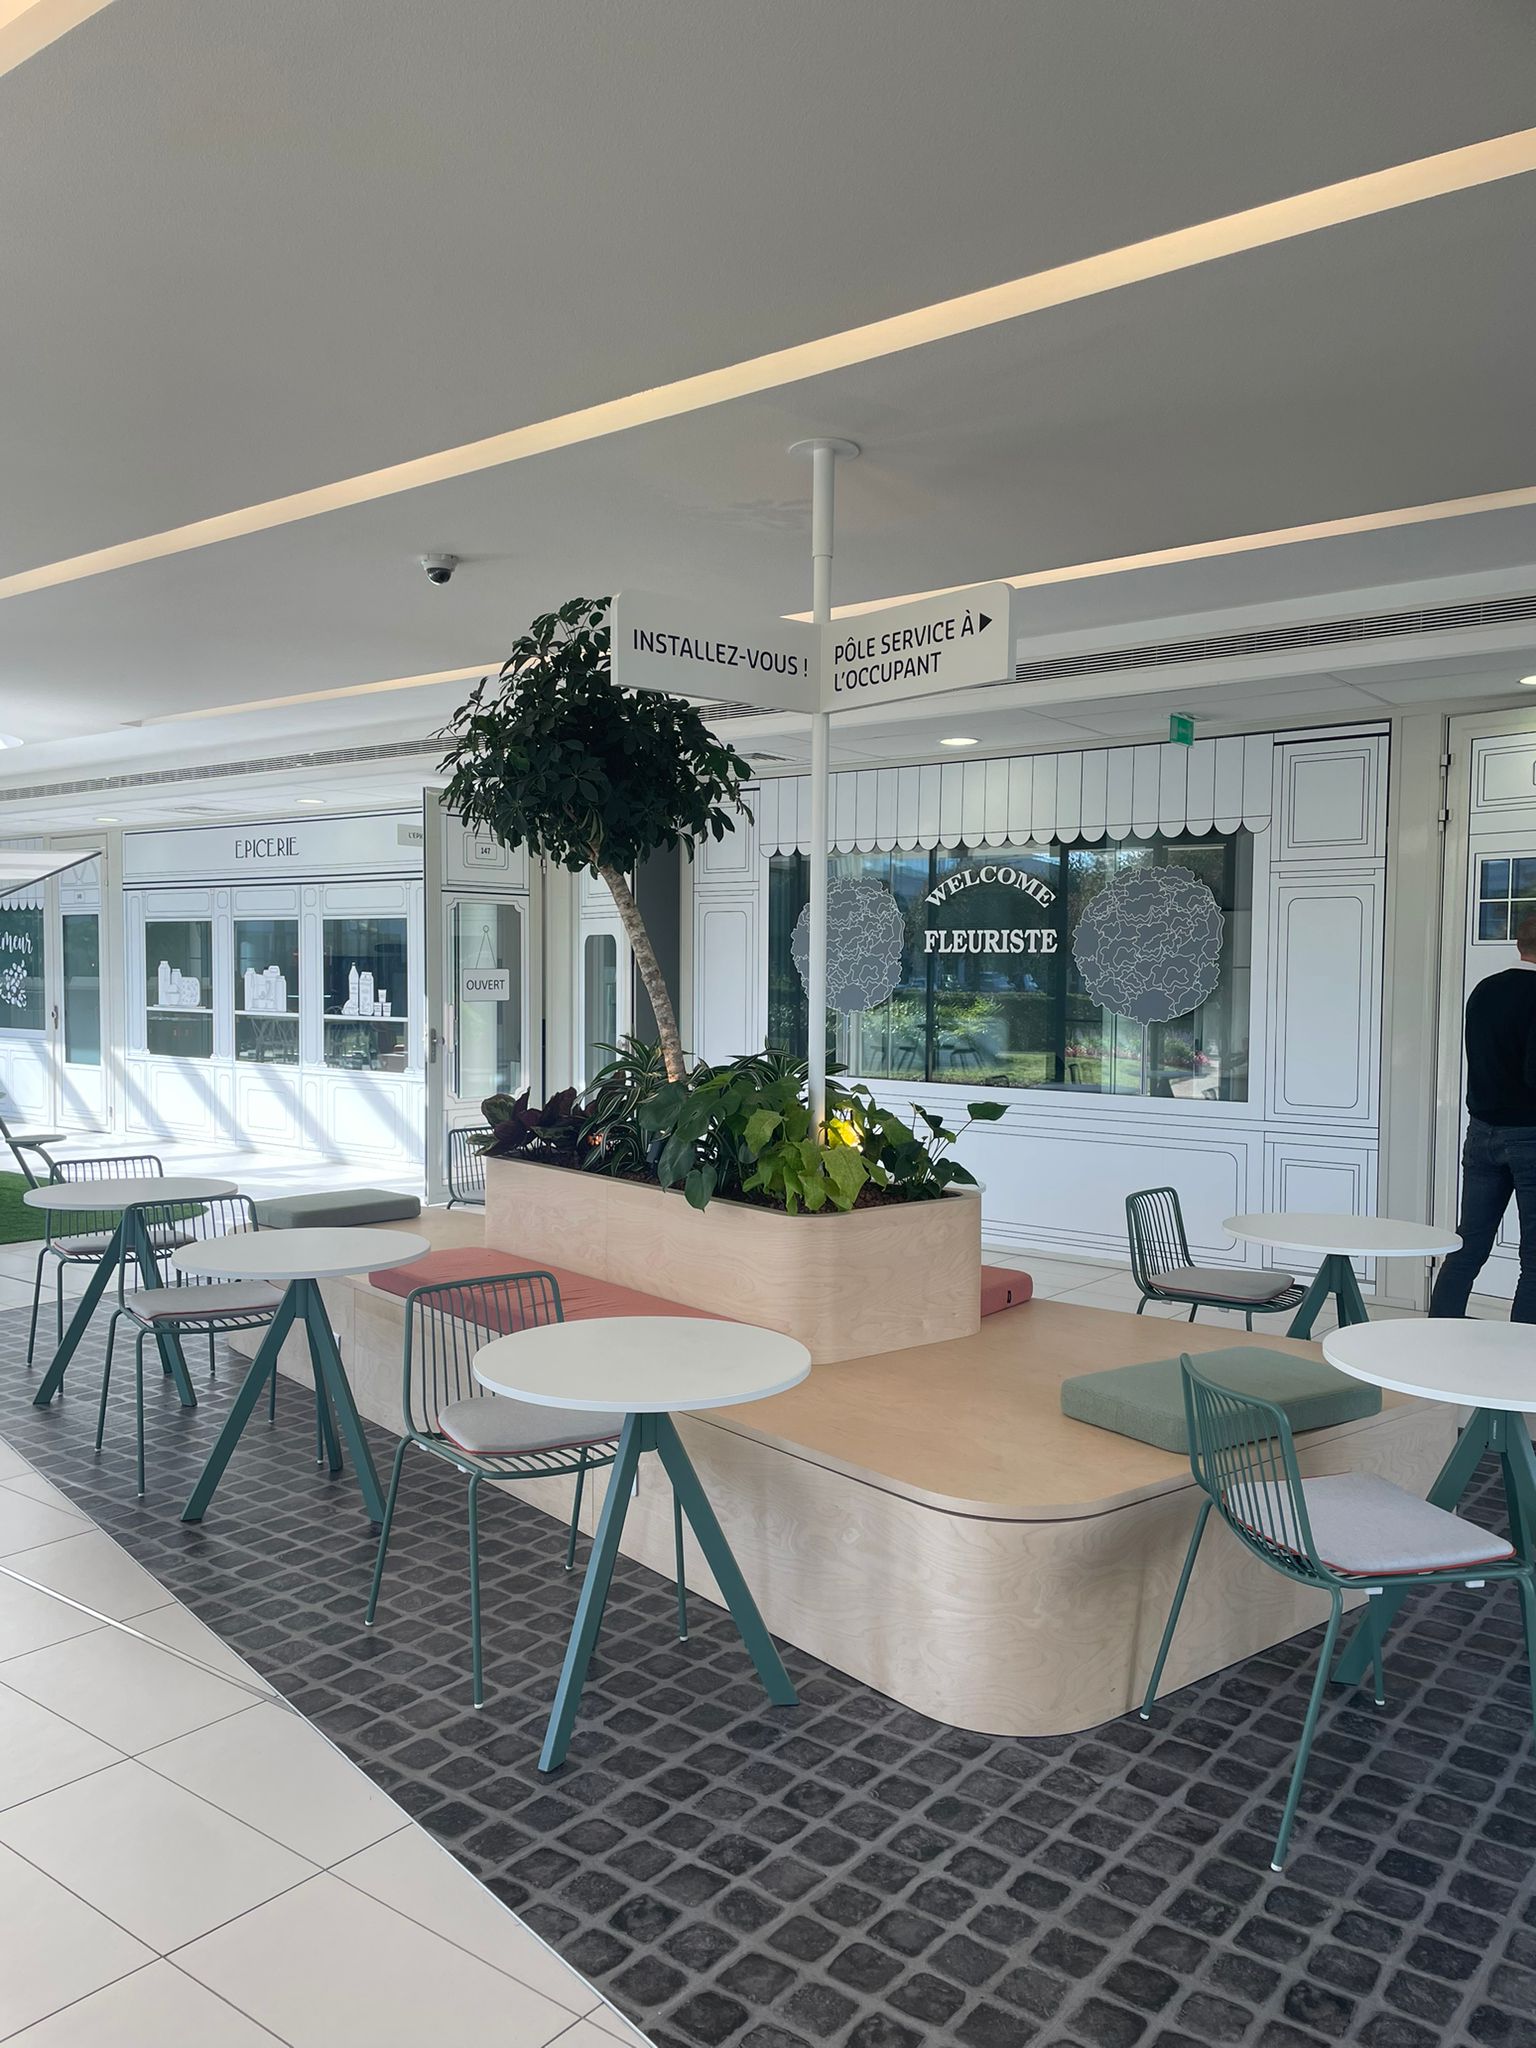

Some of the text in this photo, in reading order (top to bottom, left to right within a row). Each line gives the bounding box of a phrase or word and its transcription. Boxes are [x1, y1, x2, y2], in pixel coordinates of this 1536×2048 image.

[633, 629, 798, 676] INSTALLEZ-VOUS
[834, 609, 975, 665] PÔLE SERVICE À
[834, 651, 942, 692] L'OCCUPANT
[235, 836, 300, 859] EPICERIE
[925, 865, 1057, 909] WELCOME
[0, 930, 34, 954] meur
[924, 929, 1058, 954] FLEURISTE
[466, 979, 506, 991] OUVERT
